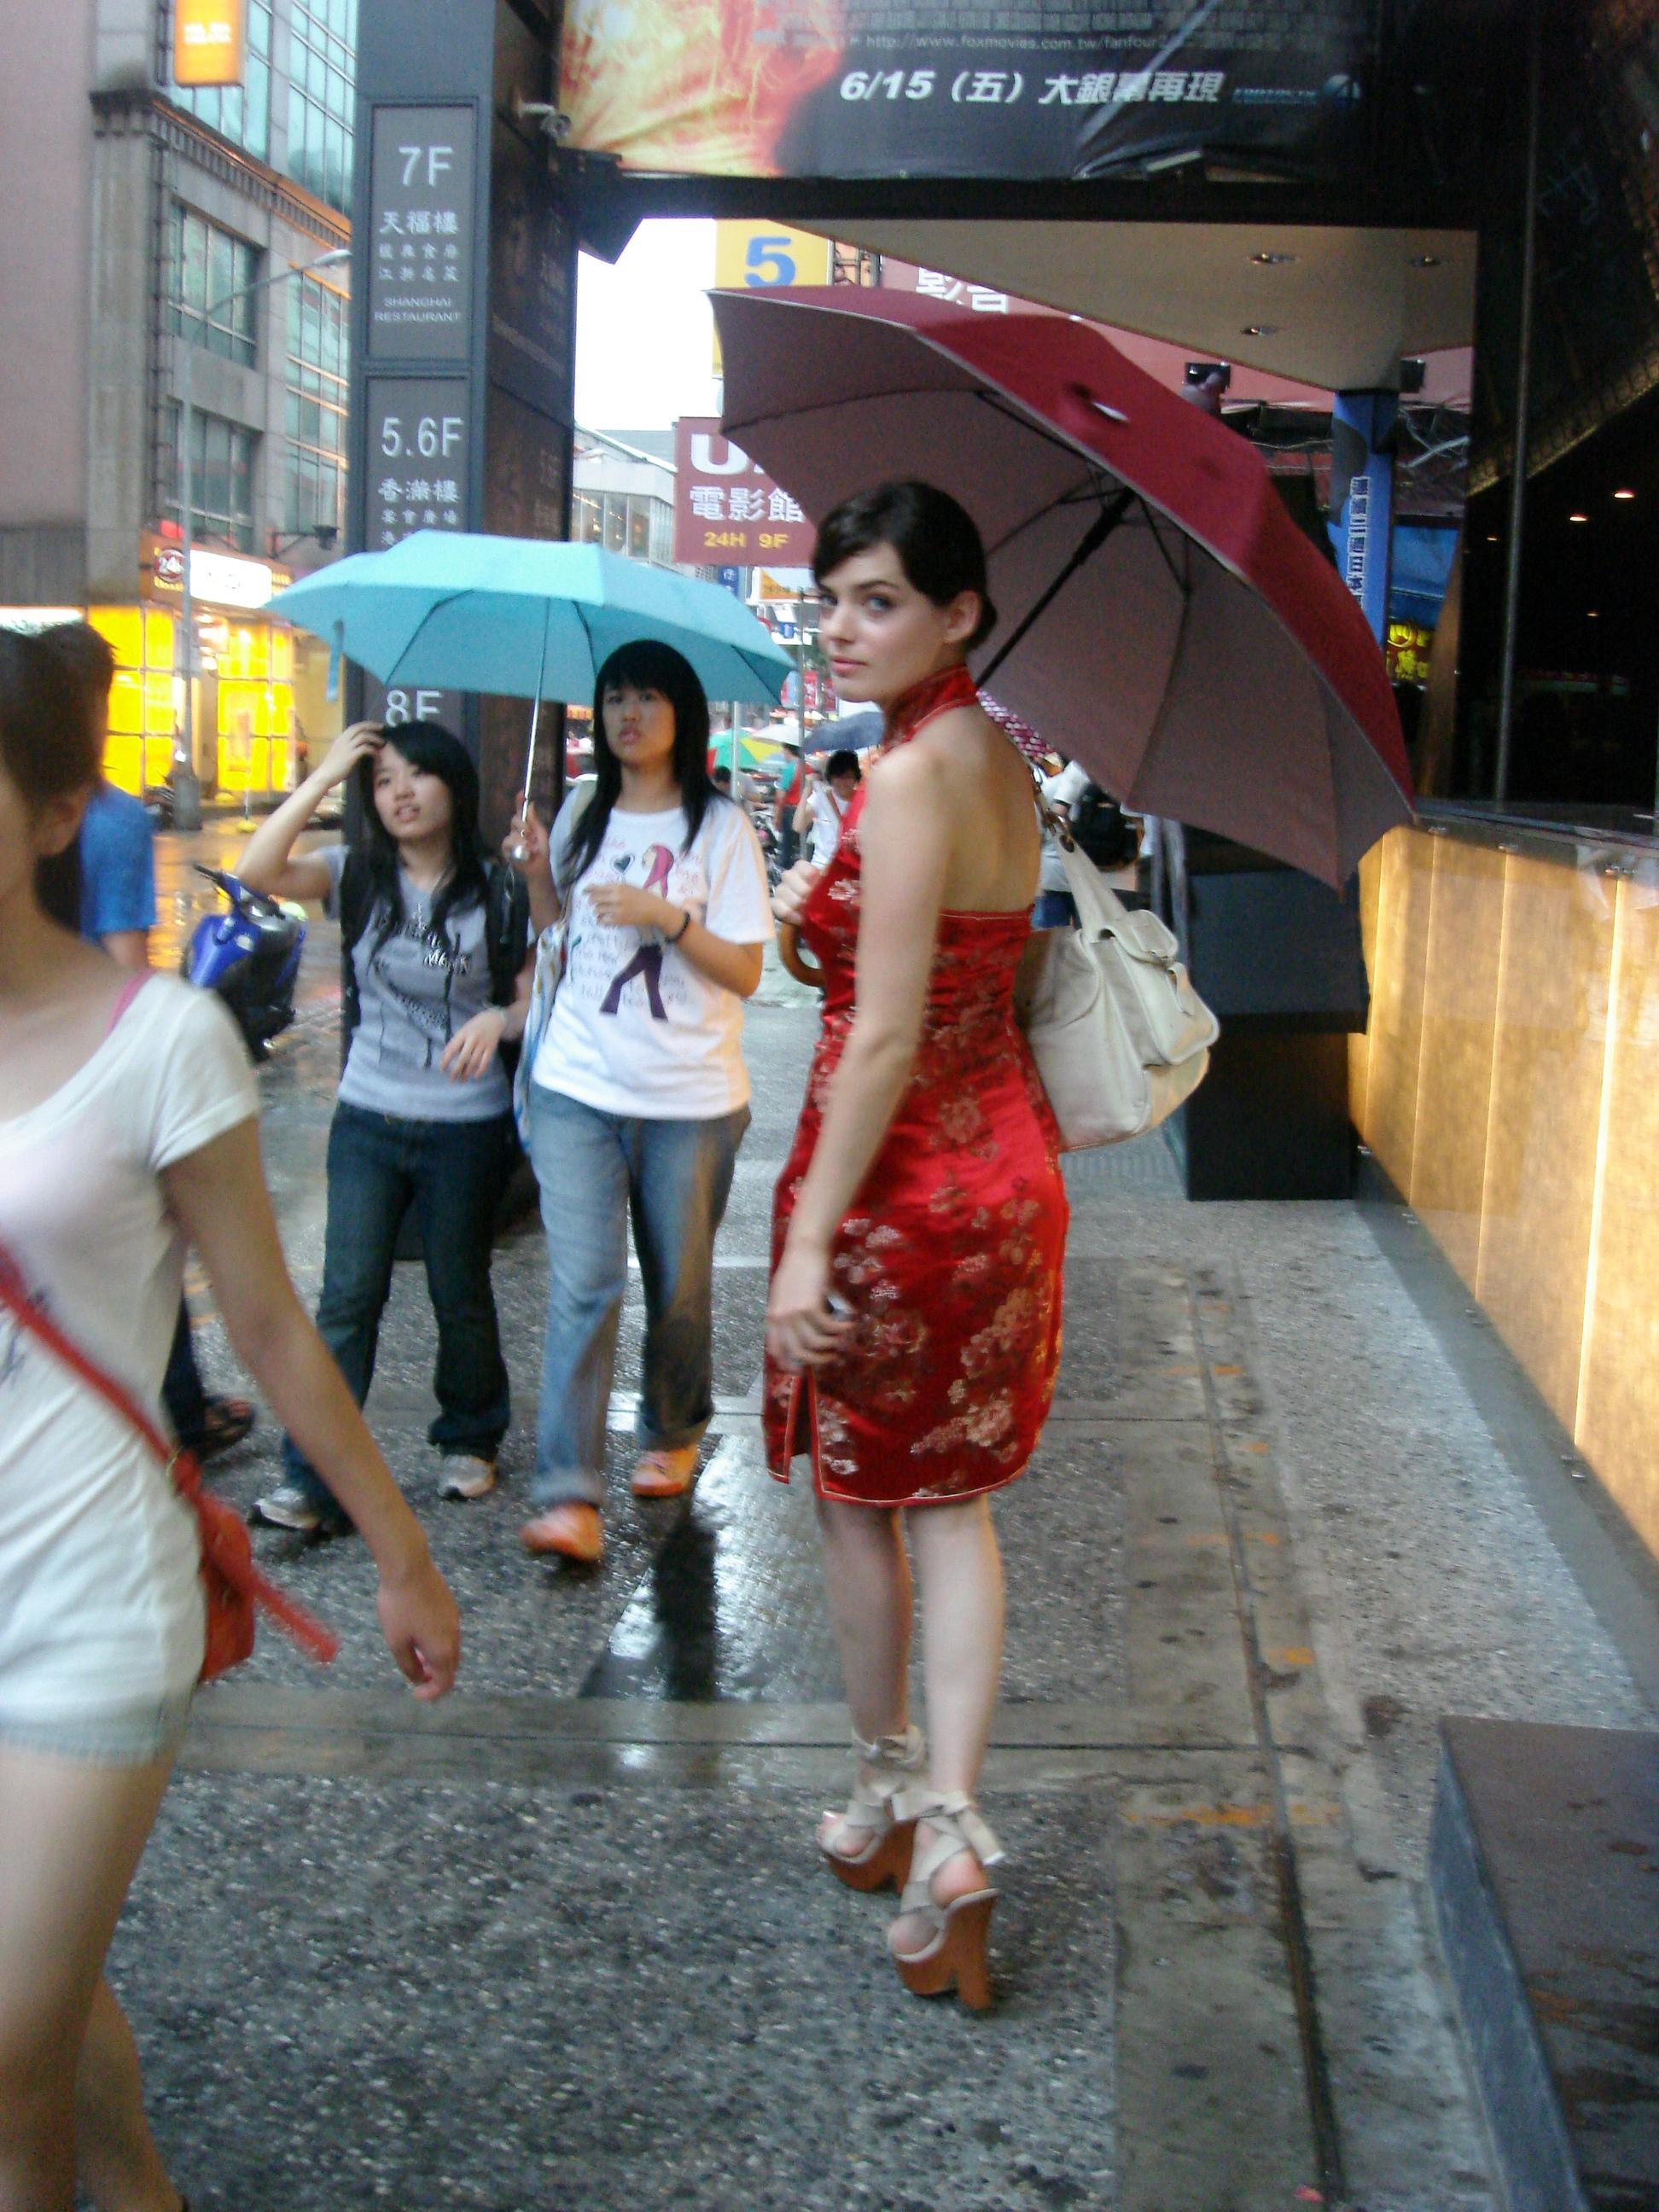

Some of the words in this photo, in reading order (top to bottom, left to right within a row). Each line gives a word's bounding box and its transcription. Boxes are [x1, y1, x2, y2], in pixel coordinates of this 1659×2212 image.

[840, 71, 935, 102] 6/15
[399, 146, 454, 187] 7F
[744, 236, 796, 288] 5
[374, 311, 462, 323] RESTAURANT
[384, 297, 451, 308] SHANGHAI
[381, 416, 464, 458] 5.6F
[689, 485, 806, 523] 電影館
[703, 531, 747, 548] 24H
[758, 533, 789, 549] 9F
[386, 689, 443, 728] 8F
